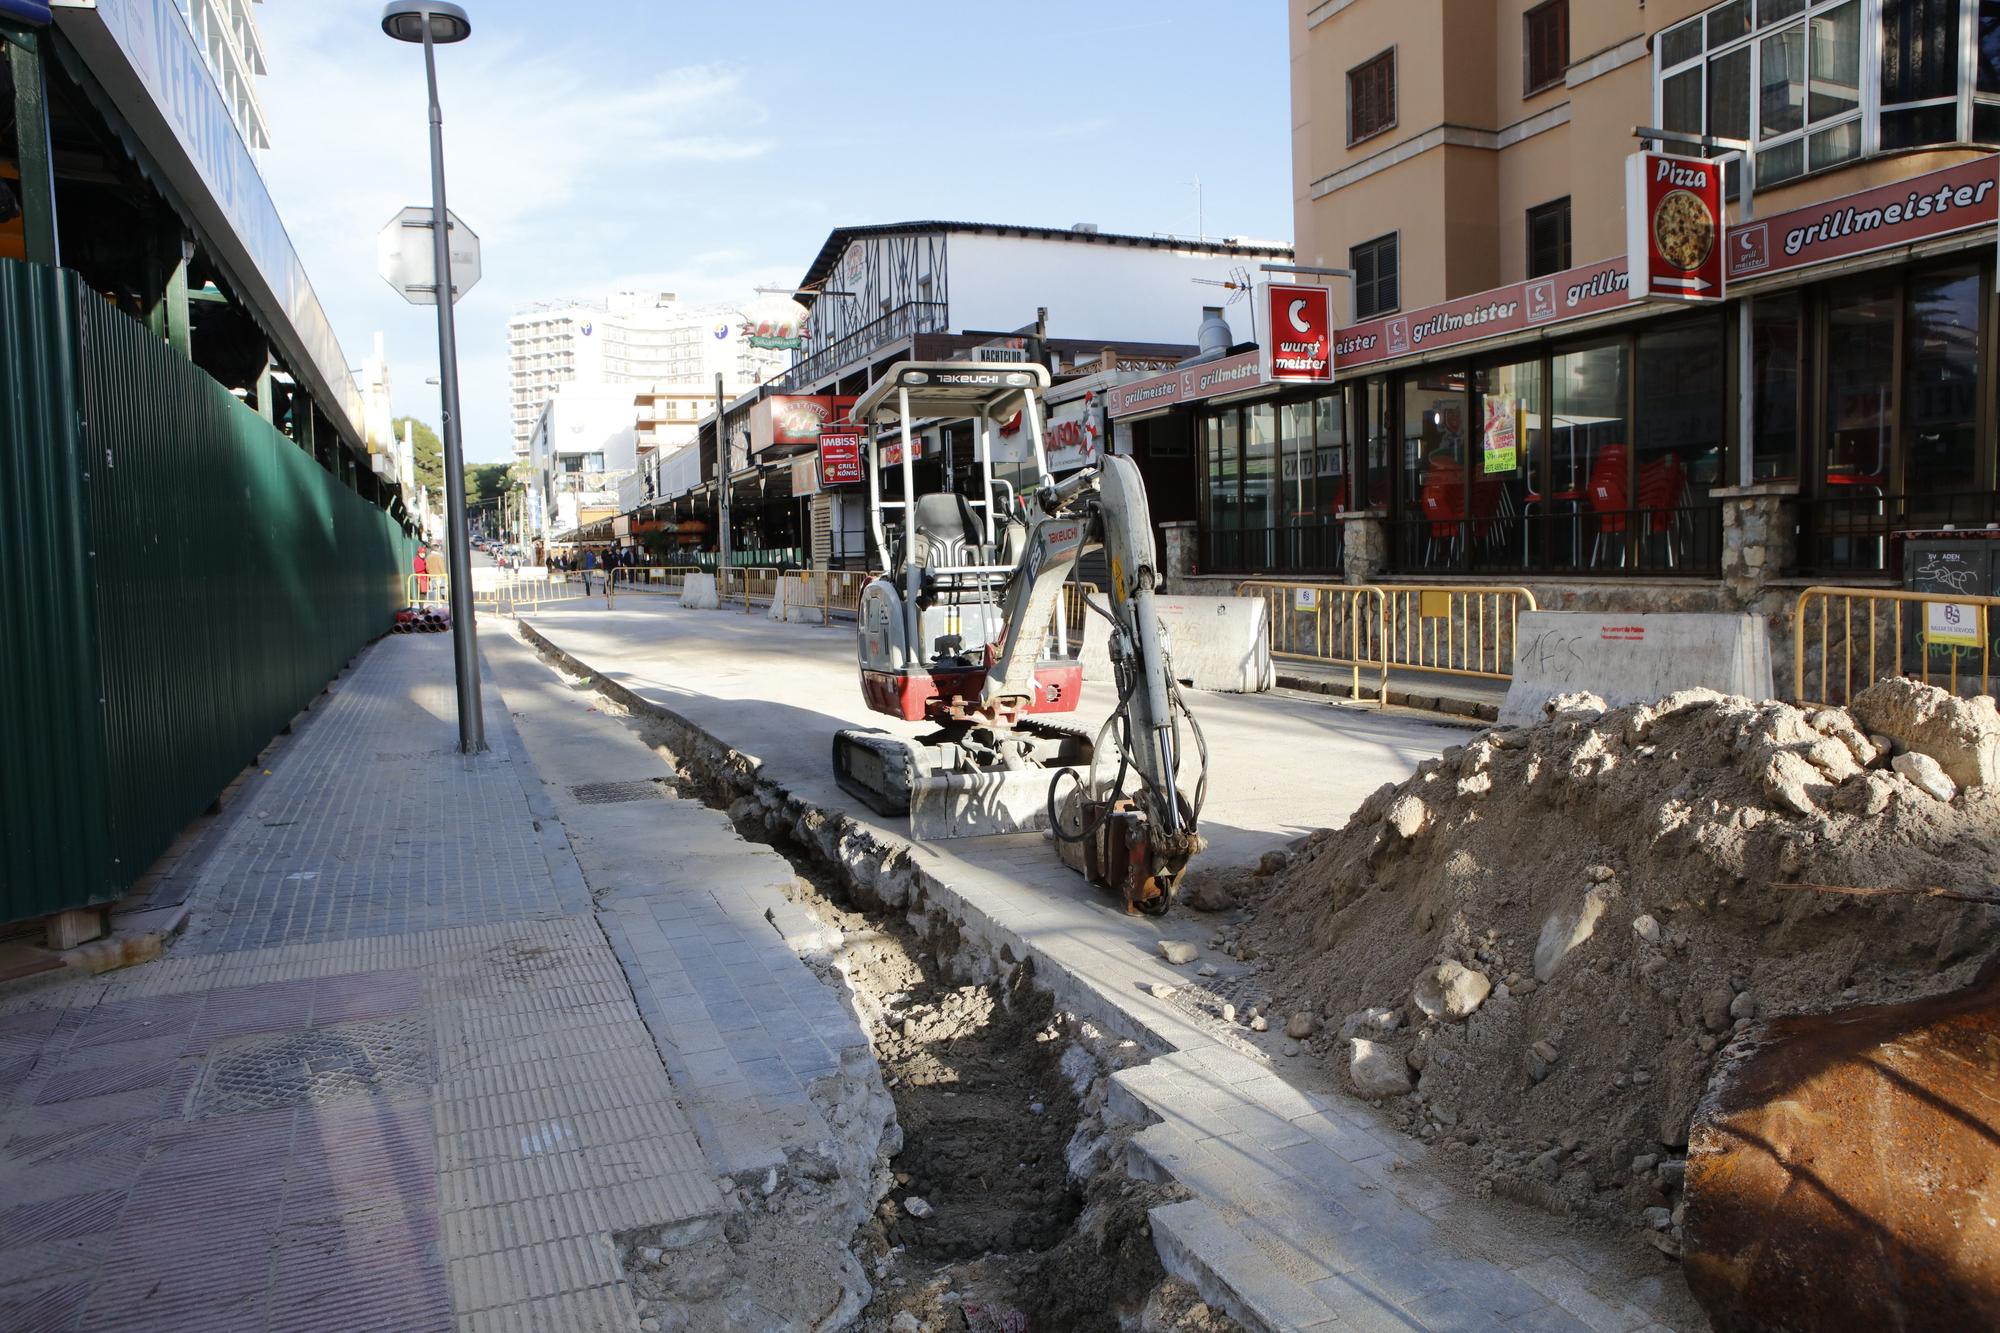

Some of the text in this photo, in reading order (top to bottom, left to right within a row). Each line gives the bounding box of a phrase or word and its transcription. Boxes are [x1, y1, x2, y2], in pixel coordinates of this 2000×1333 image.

[1656, 159, 1707, 188] Pizza
[1784, 178, 1995, 256] grillmeister
[1412, 301, 1518, 343] grillmeister
[980, 349, 1021, 362] NACHTCLUB
[1280, 340, 1320, 353] wurst
[1276, 357, 1326, 370] meister
[1124, 382, 1177, 407] grillmeister
[822, 437, 856, 447] IMBISS
